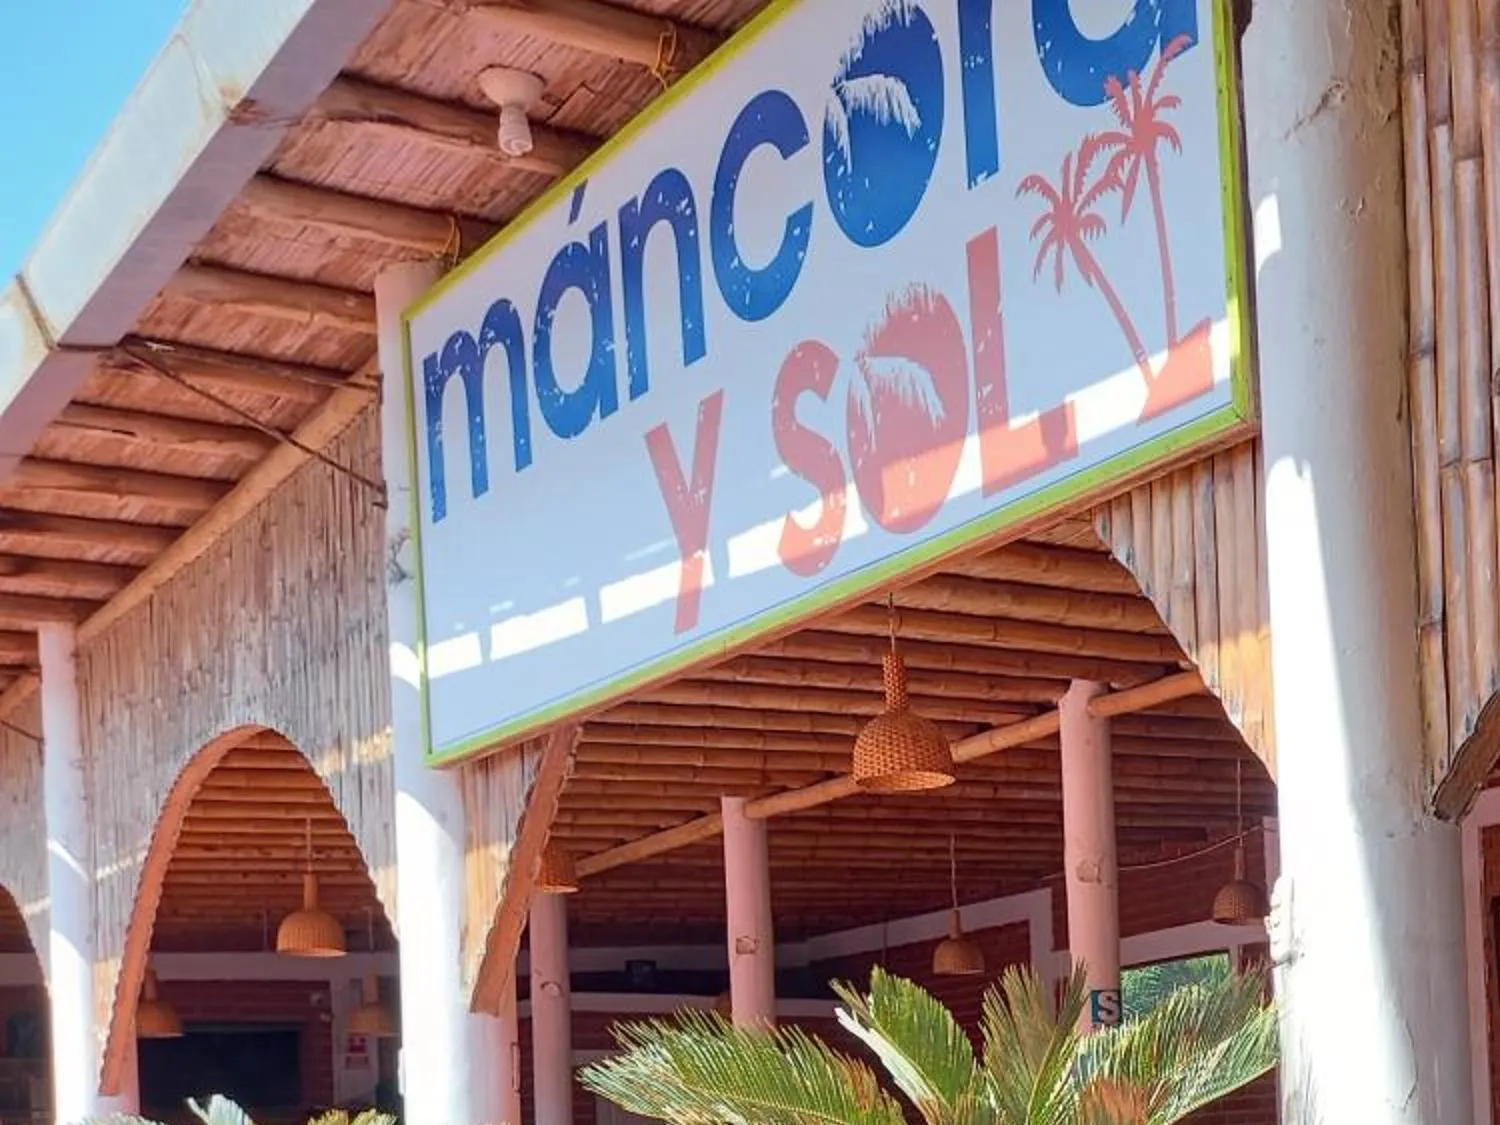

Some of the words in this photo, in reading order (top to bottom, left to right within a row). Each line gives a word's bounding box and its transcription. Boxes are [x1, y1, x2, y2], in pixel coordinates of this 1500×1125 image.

[643, 389, 725, 636] Y
[771, 226, 1079, 578] SOL
[1098, 989, 1120, 1024] S
